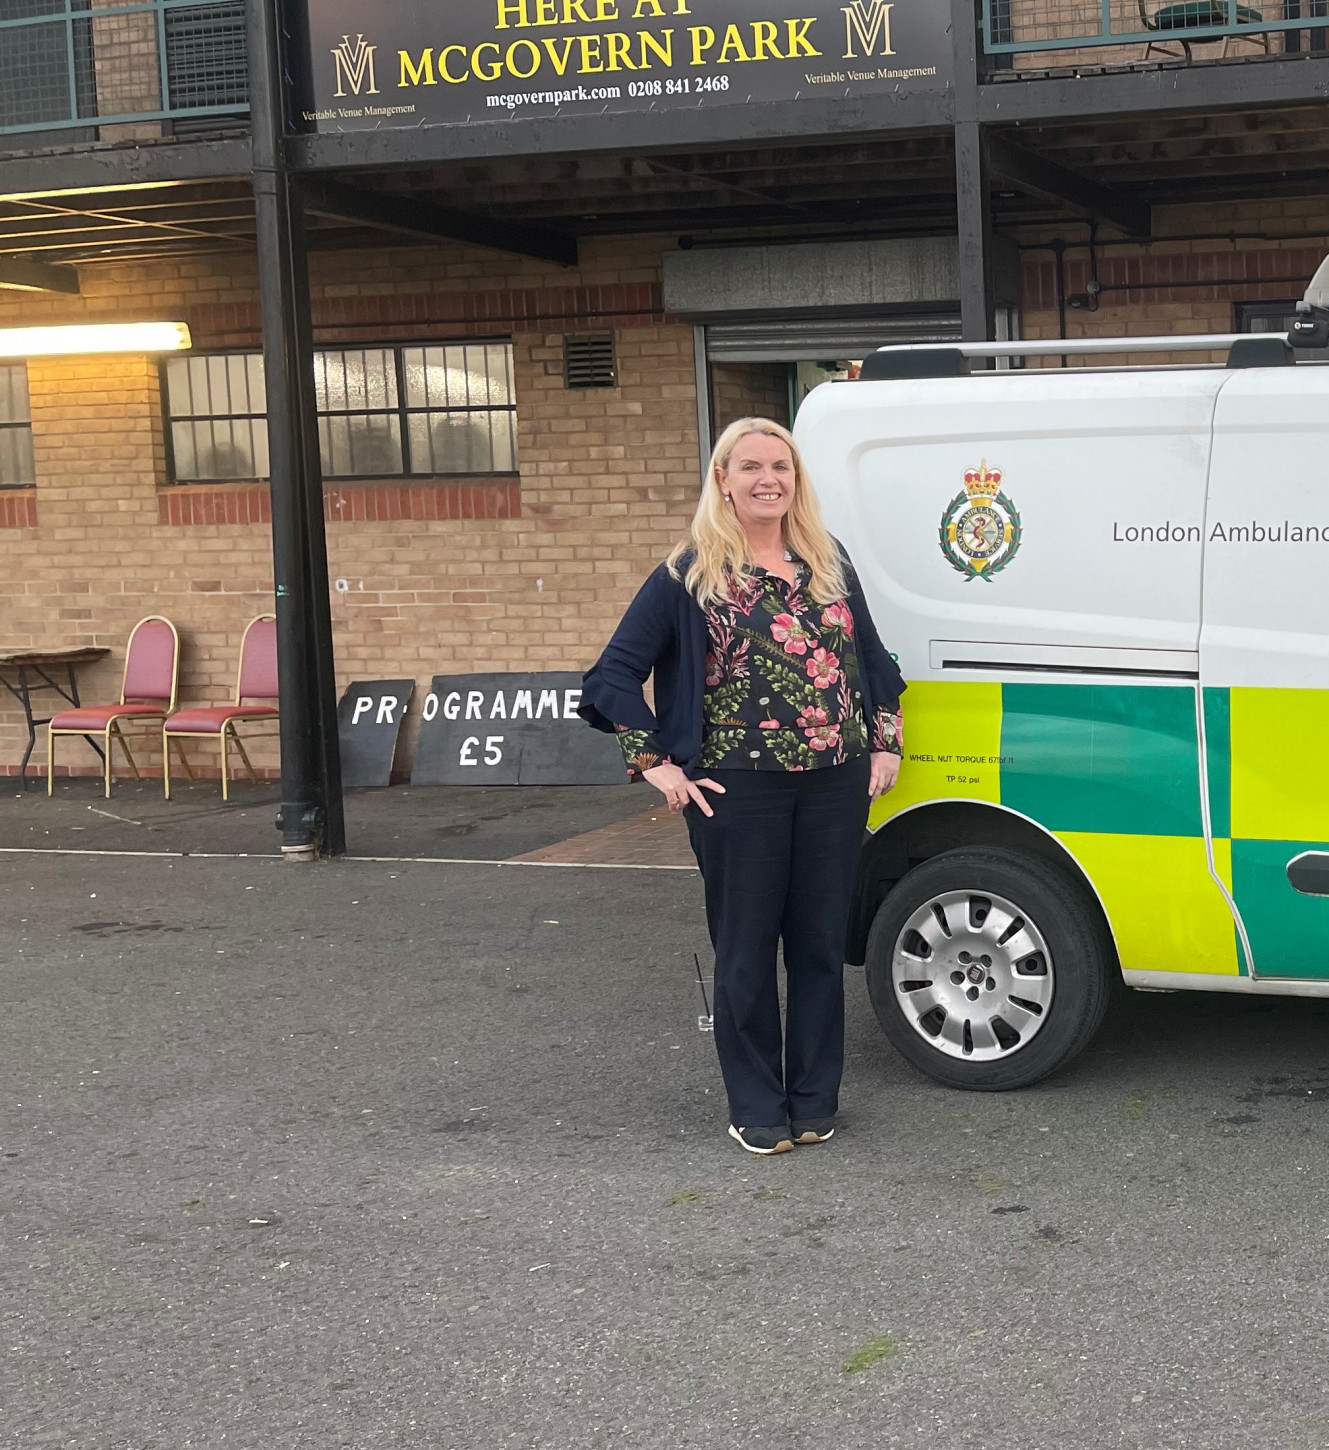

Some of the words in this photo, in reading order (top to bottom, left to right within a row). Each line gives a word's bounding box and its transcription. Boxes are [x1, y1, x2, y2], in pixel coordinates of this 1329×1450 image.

[495, 0, 618, 29] HERE
[397, 29, 674, 87] MCGOVERN
[687, 17, 823, 66] PARK
[805, 71, 845, 84] Veritable
[847, 70, 875, 81] Venue
[877, 66, 936, 80] Management
[486, 85, 621, 109] mcgovernpark.com
[628, 79, 662, 97] 0208
[665, 77, 690, 95] 841
[695, 75, 730, 92] 2468
[302, 109, 336, 121] Veritable
[338, 107, 362, 118] Venue
[364, 104, 416, 117] Management
[1113, 520, 1200, 542] London
[459, 736, 504, 766] £5
[909, 754, 935, 762] WHEEL
[938, 755, 952, 763] NUT
[956, 755, 986, 764] TORQUE
[946, 775, 956, 783] TP
